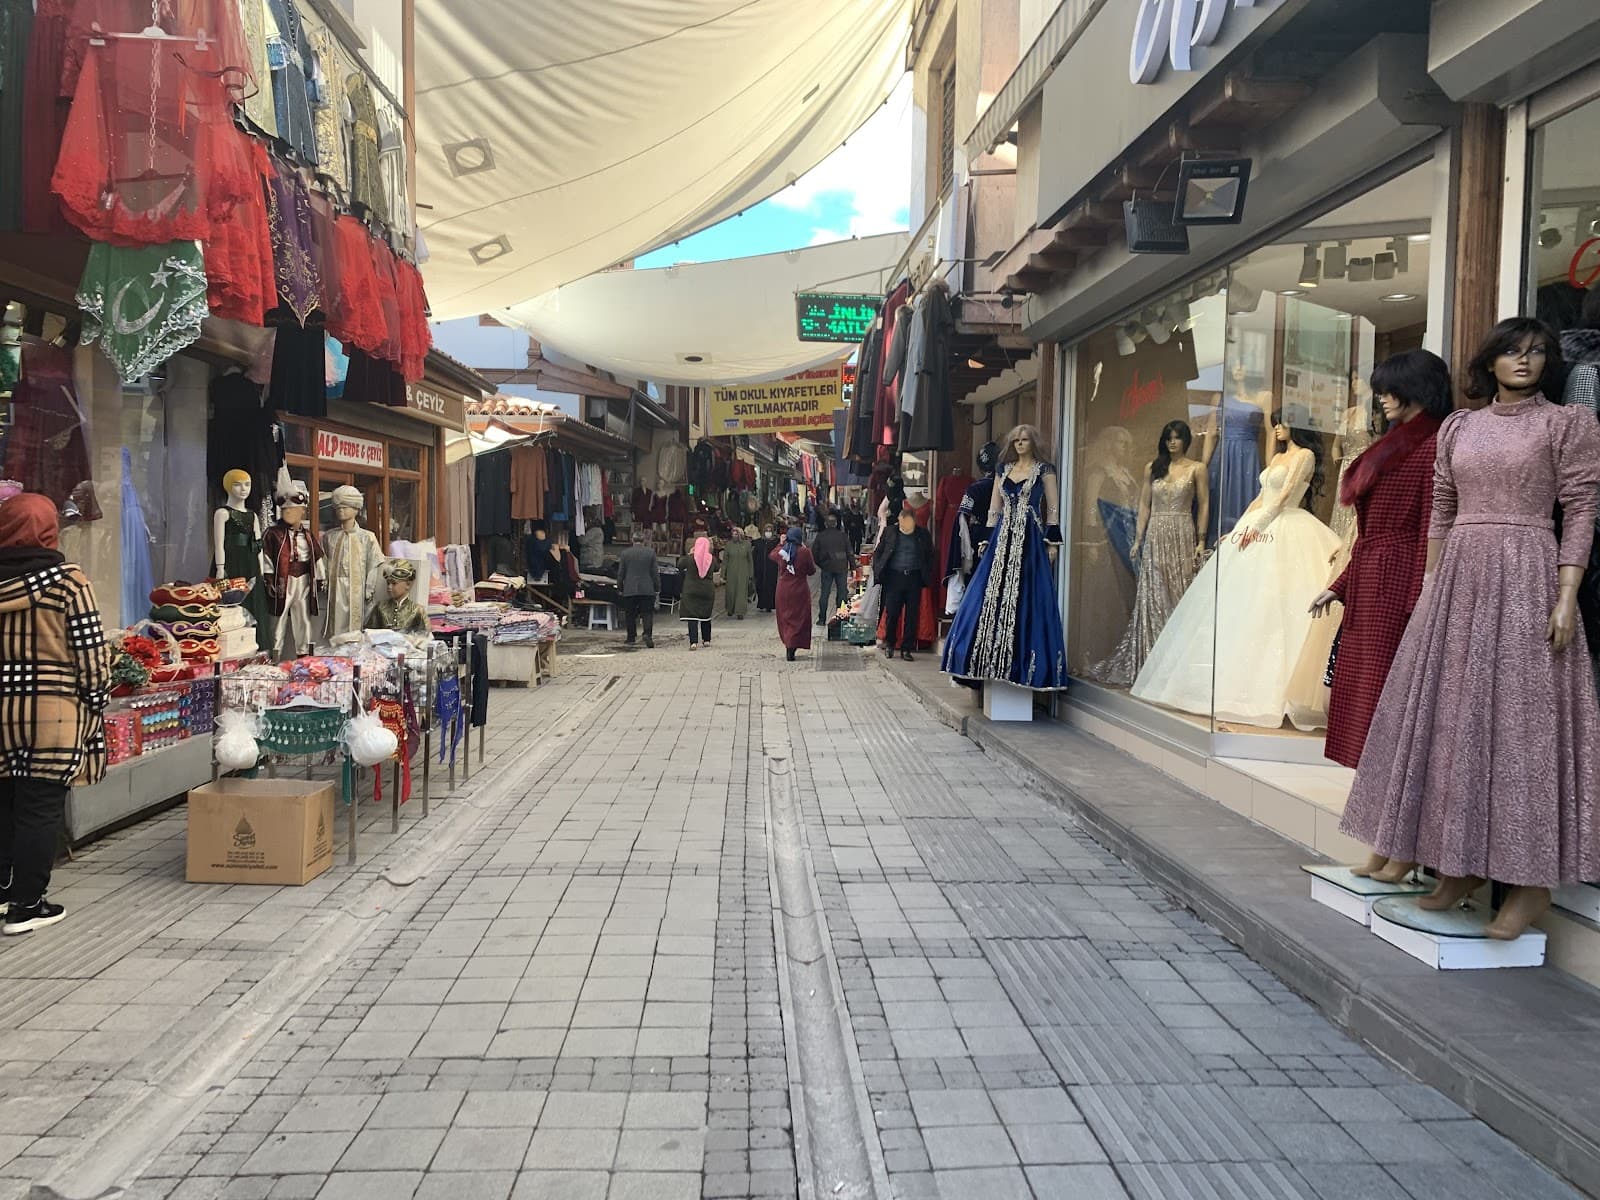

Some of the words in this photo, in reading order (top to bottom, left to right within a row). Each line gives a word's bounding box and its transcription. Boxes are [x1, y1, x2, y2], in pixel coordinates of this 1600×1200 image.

[406, 385, 412, 400] &
[416, 390, 445, 414] ÇEYİZ
[714, 387, 737, 402] TÜM
[740, 388, 768, 400] OKUL
[770, 381, 838, 399] KIYAFETLERİ
[734, 400, 819, 415] SATILMAKTADIR
[317, 433, 339, 458] ALP
[339, 440, 360, 458] PERDE
[361, 445, 366, 460] &
[366, 444, 382, 464] ÇEYİZ
